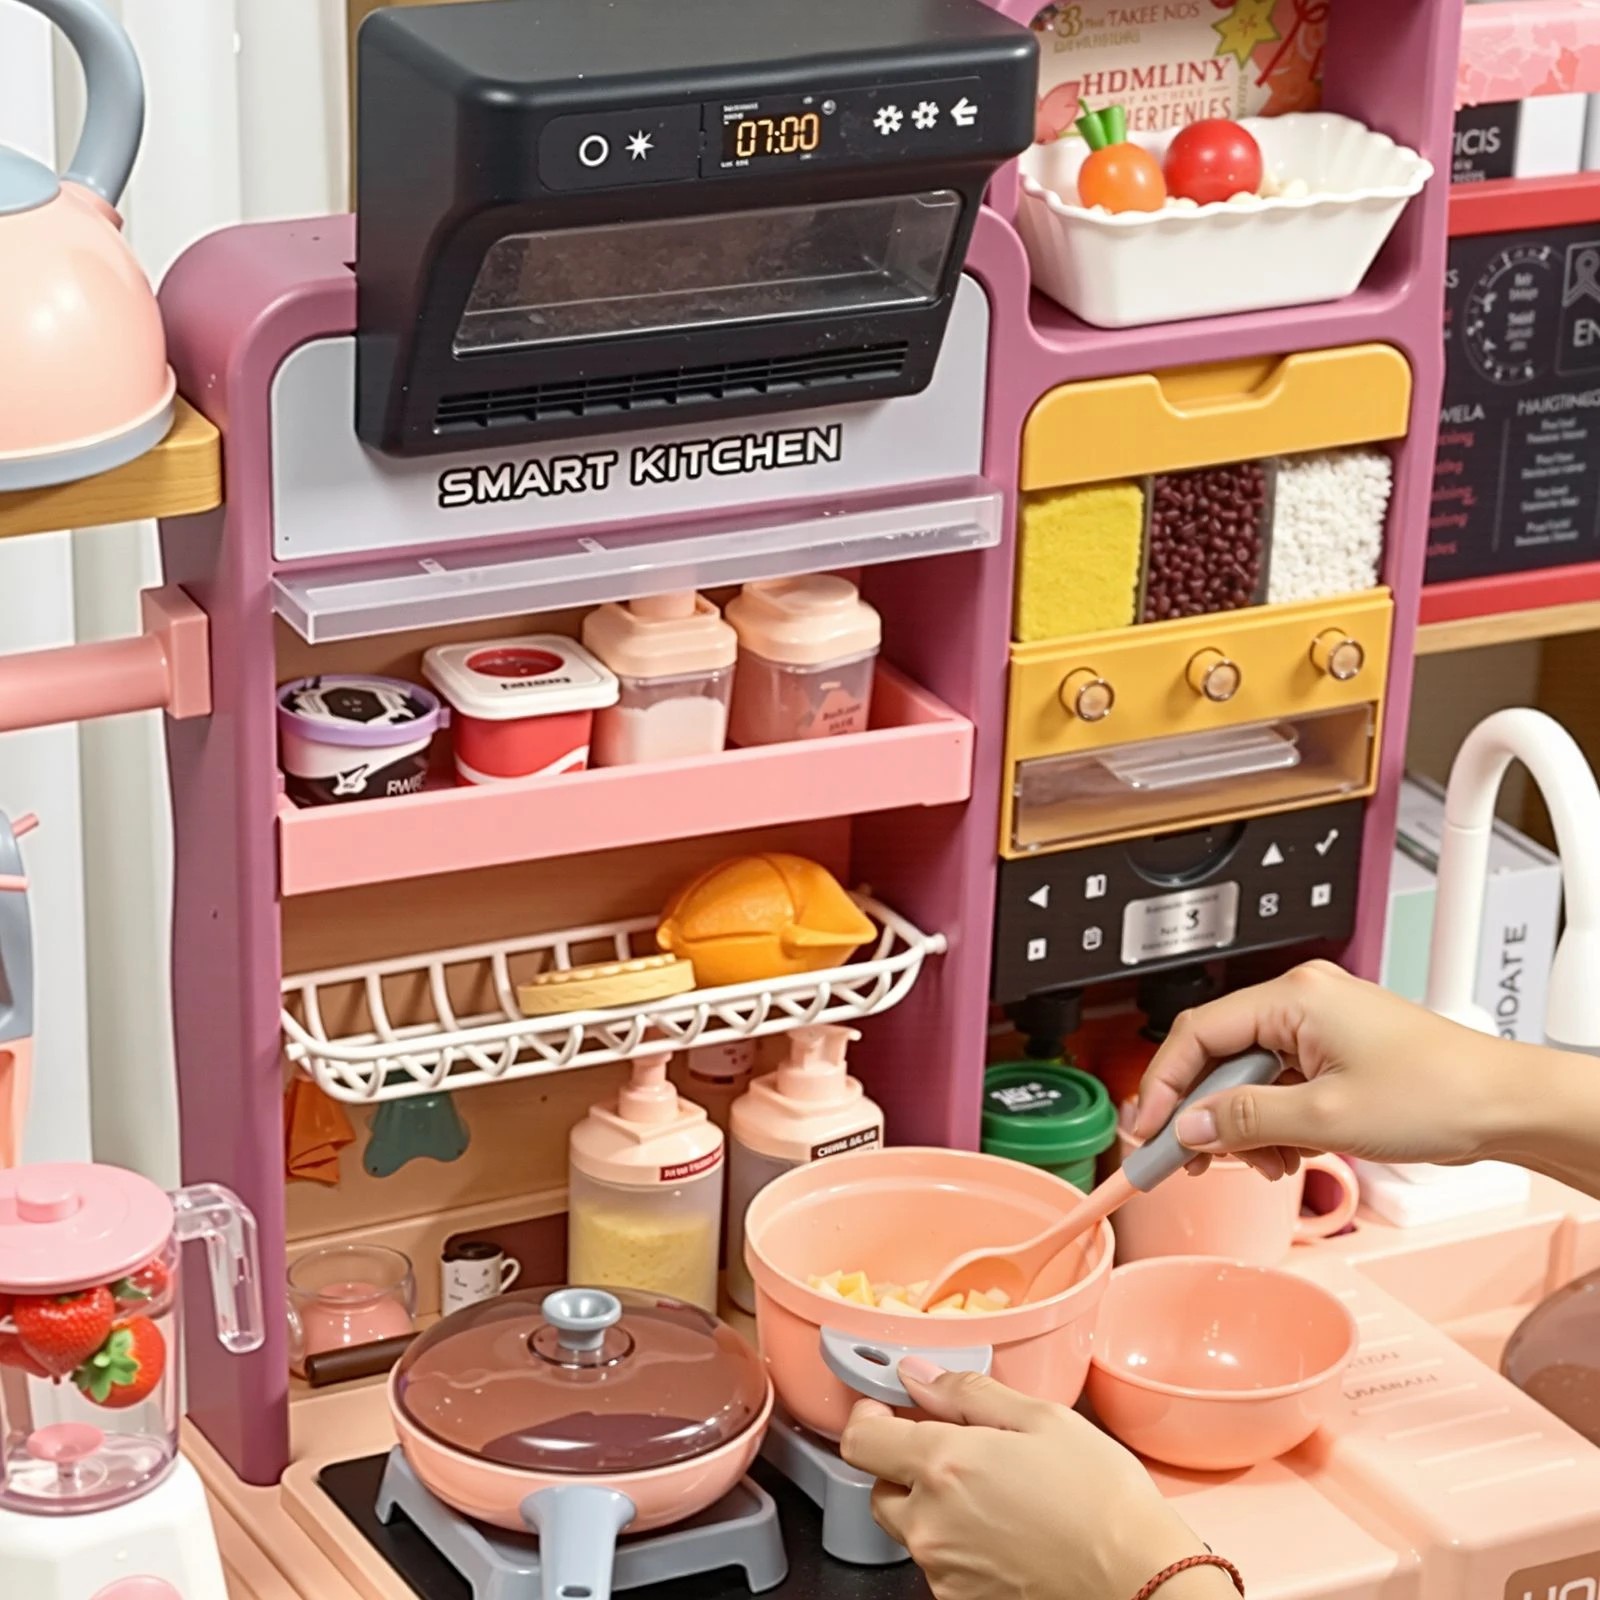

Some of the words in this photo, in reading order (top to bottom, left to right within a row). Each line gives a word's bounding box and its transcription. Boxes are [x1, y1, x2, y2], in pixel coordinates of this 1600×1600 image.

[736, 112, 819, 157] 07:00
[439, 450, 619, 508] SMART
[630, 423, 843, 487] KITCHEN
